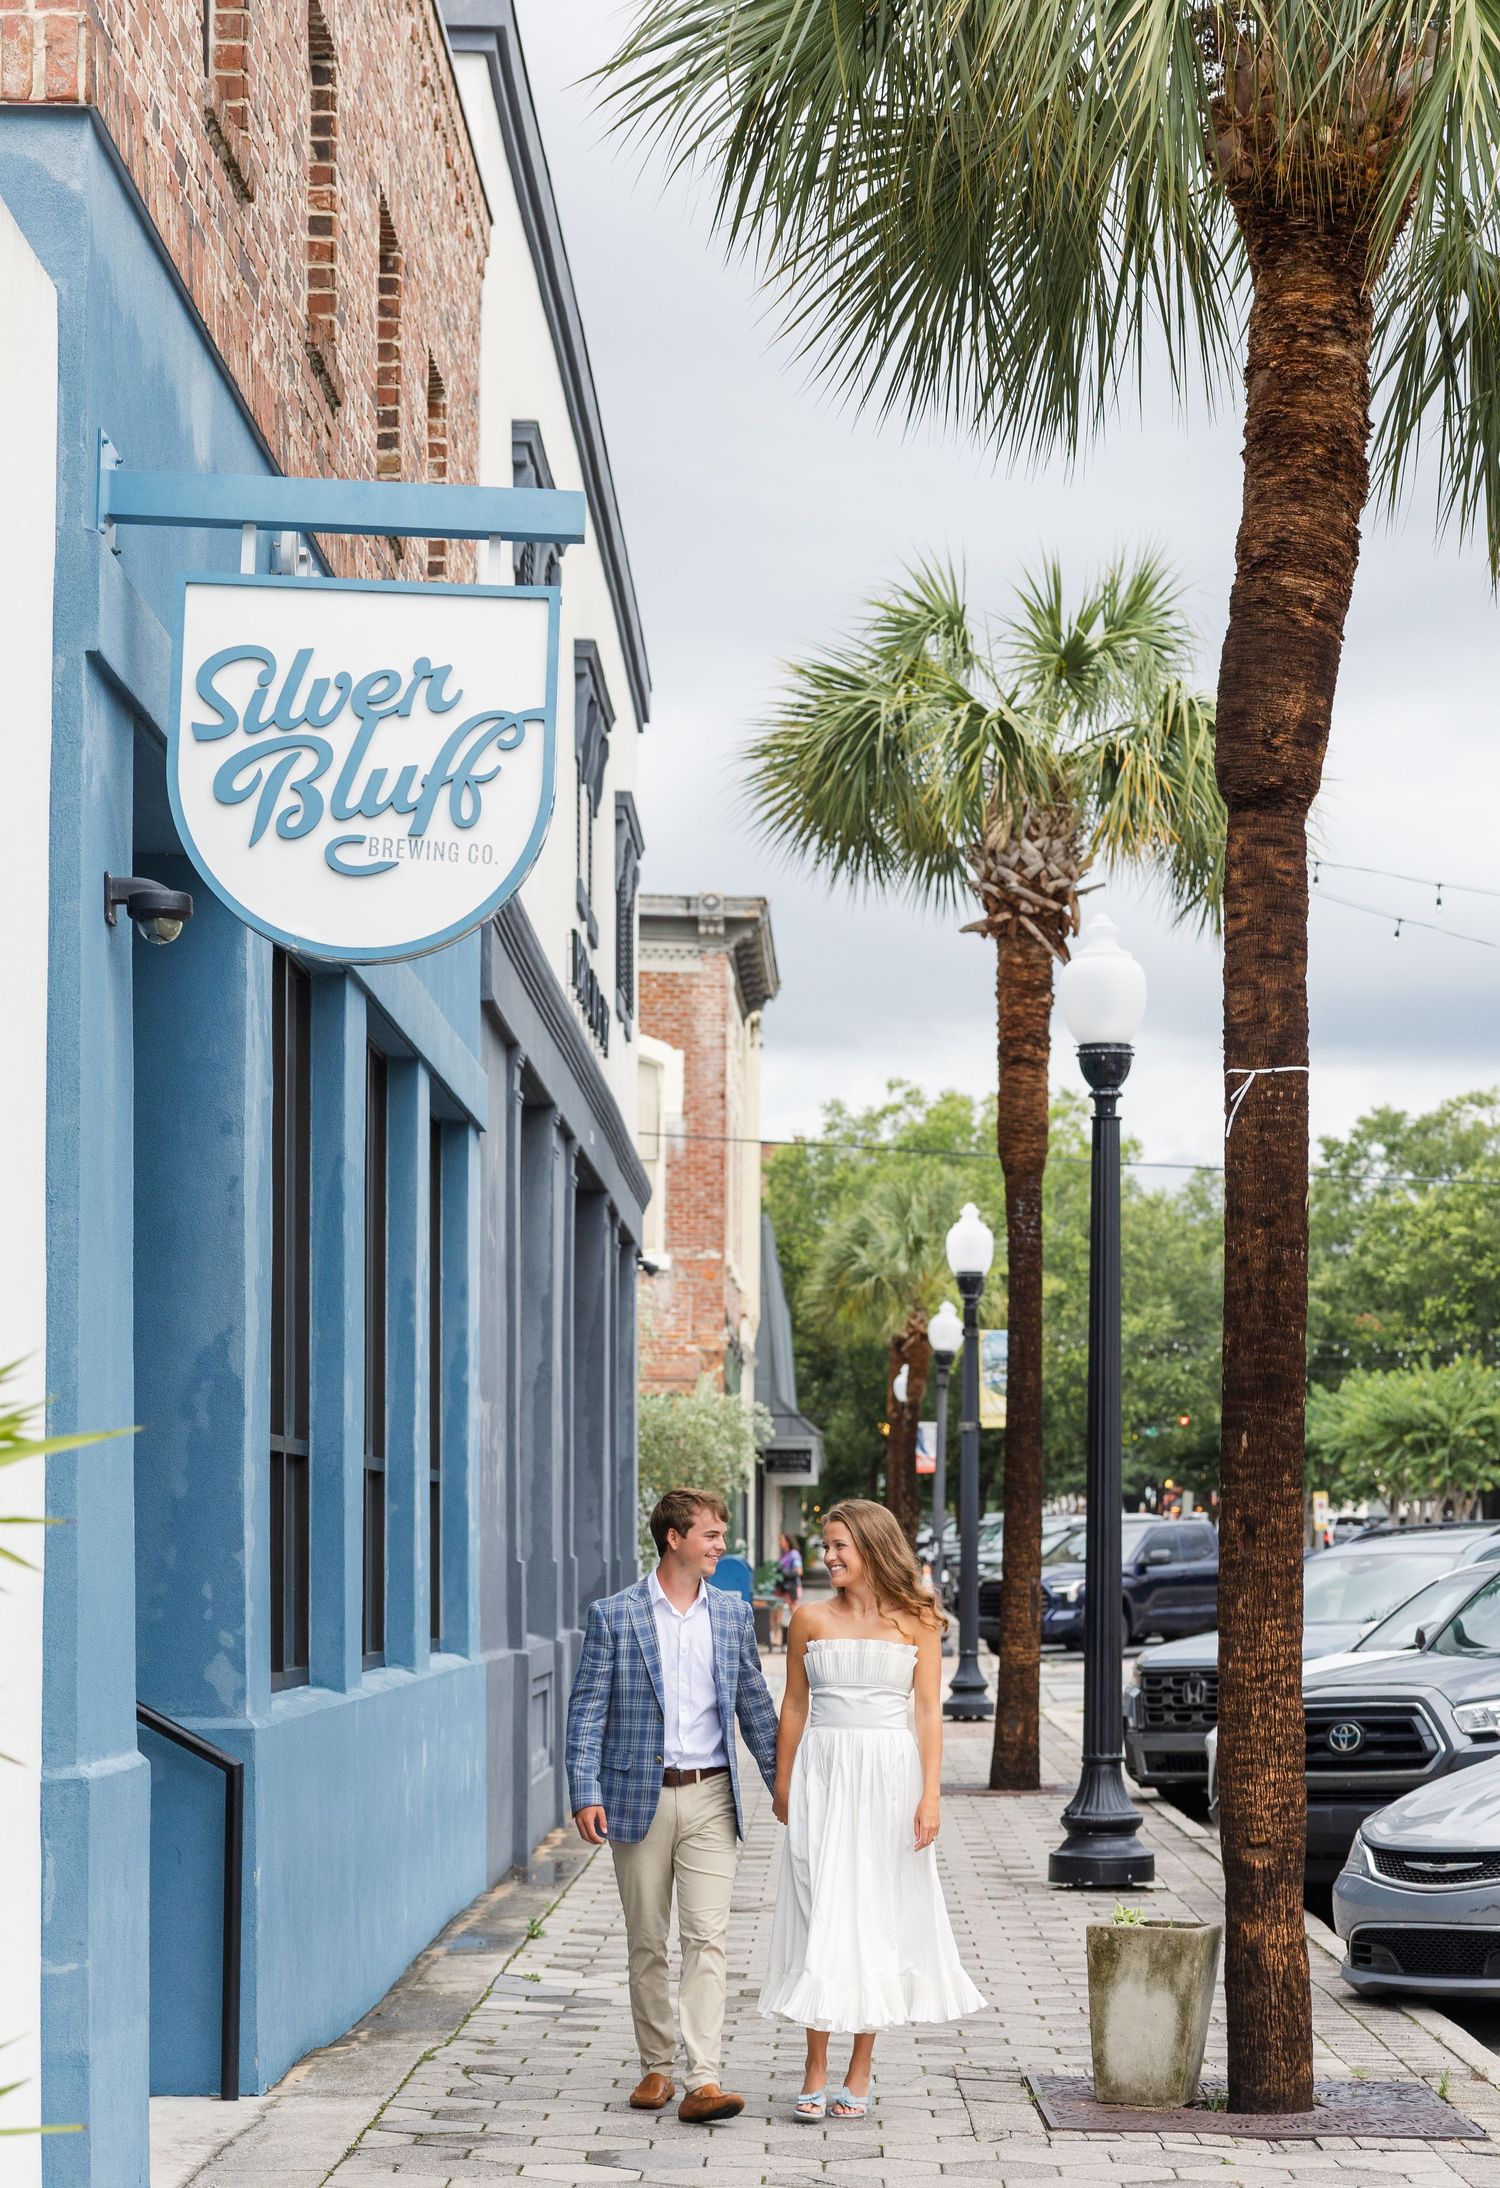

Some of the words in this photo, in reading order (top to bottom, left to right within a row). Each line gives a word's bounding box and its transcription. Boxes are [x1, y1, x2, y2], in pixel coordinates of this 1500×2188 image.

[191, 644, 464, 743] Silver
[213, 708, 538, 849] Bluff
[367, 836, 460, 864] BREWING
[467, 843, 499, 866] CO.
